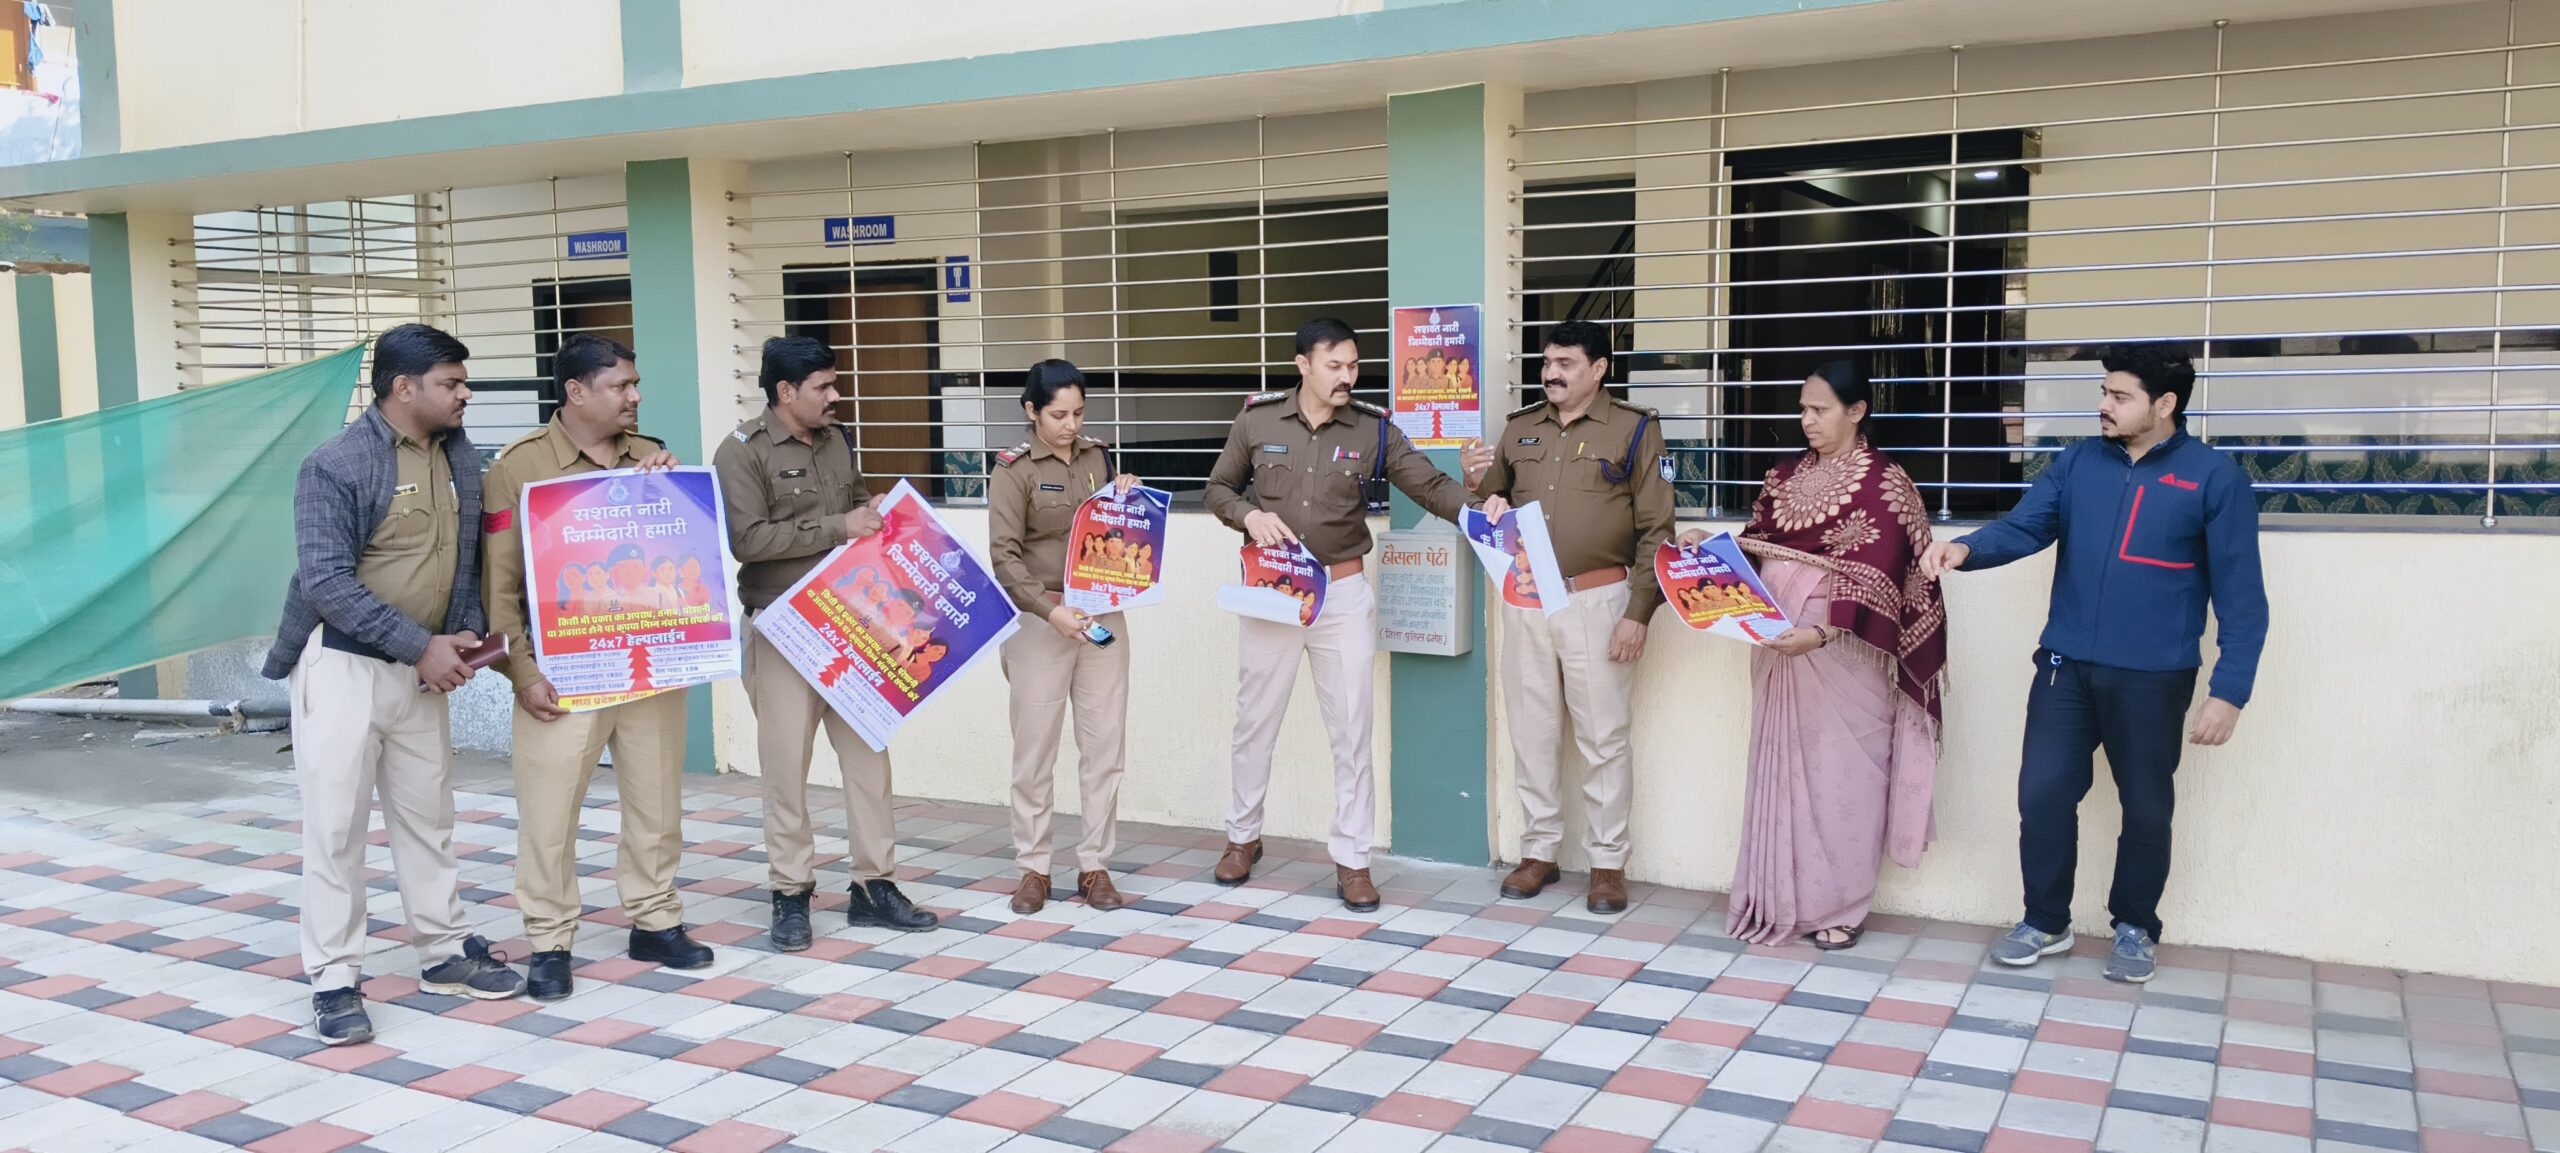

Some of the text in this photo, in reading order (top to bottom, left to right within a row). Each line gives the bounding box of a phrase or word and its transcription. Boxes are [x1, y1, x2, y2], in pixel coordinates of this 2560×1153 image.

[832, 223, 887, 239] WASHROOM
[574, 240, 621, 254] WASHROOM
[1442, 321, 1459, 333] नारी
[1444, 334, 1466, 346] हमारी
[637, 499, 672, 516] नारी
[1126, 502, 1146, 516] नारी
[562, 518, 687, 544] जिम्मेदारी हमारी
[1127, 519, 1151, 530] हमारी
[1291, 552, 1307, 563] नारी
[1381, 544, 1450, 567] हौसला पेटी
[1258, 557, 1314, 577] जिम्मेदारी हमारी
[886, 544, 970, 629] जिम्मेदारी हमारी
[947, 579, 975, 608] नारी
[558, 616, 579, 626] किसी
[580, 614, 590, 624] भी
[591, 615, 612, 623] प्रकार
[819, 623, 846, 646] 24x7
[589, 636, 623, 650] 24x7
